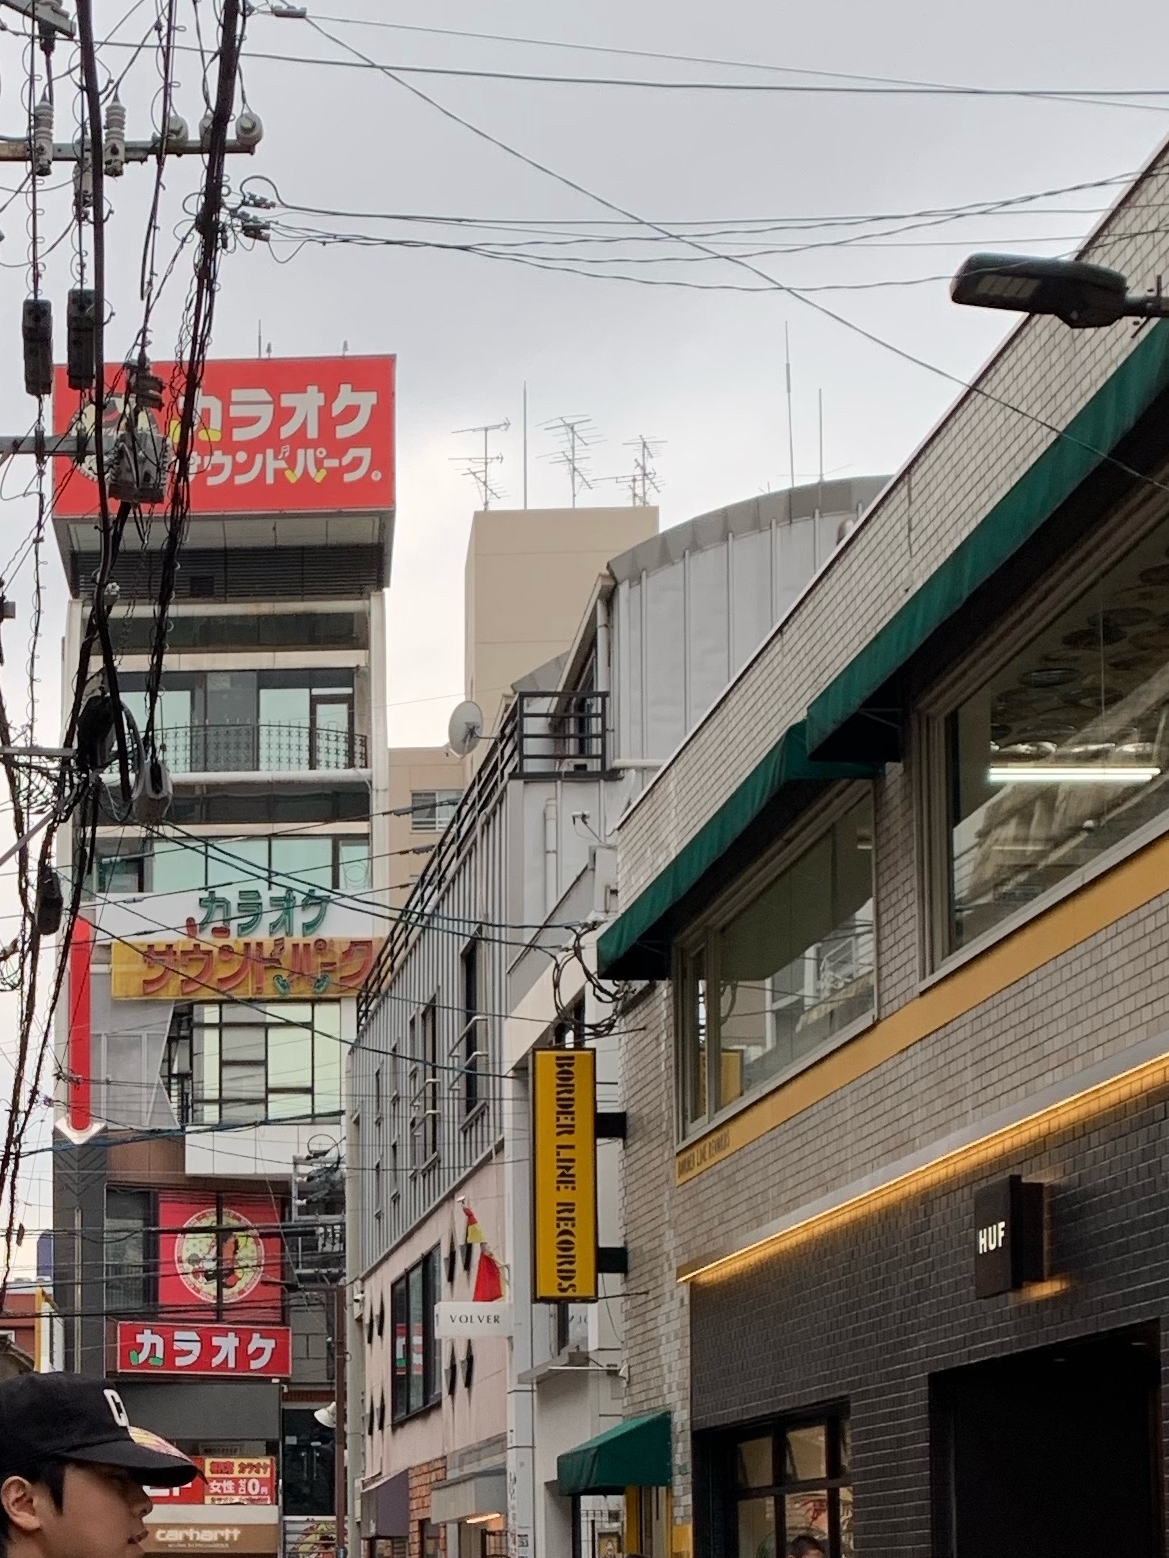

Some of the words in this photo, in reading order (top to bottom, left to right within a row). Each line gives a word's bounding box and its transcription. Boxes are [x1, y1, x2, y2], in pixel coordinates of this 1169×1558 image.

[197, 889, 331, 937] カラオケ
[142, 939, 374, 994] サウンドパーク
[555, 1055, 575, 1137] BORDER
[556, 1145, 576, 1191] LINE
[556, 1202, 577, 1293] RECORDS
[978, 1221, 1005, 1254] HUF
[449, 1314, 500, 1324] VOLVER
[134, 1329, 276, 1370] カラオケ
[155, 1528, 240, 1541] carhartt
